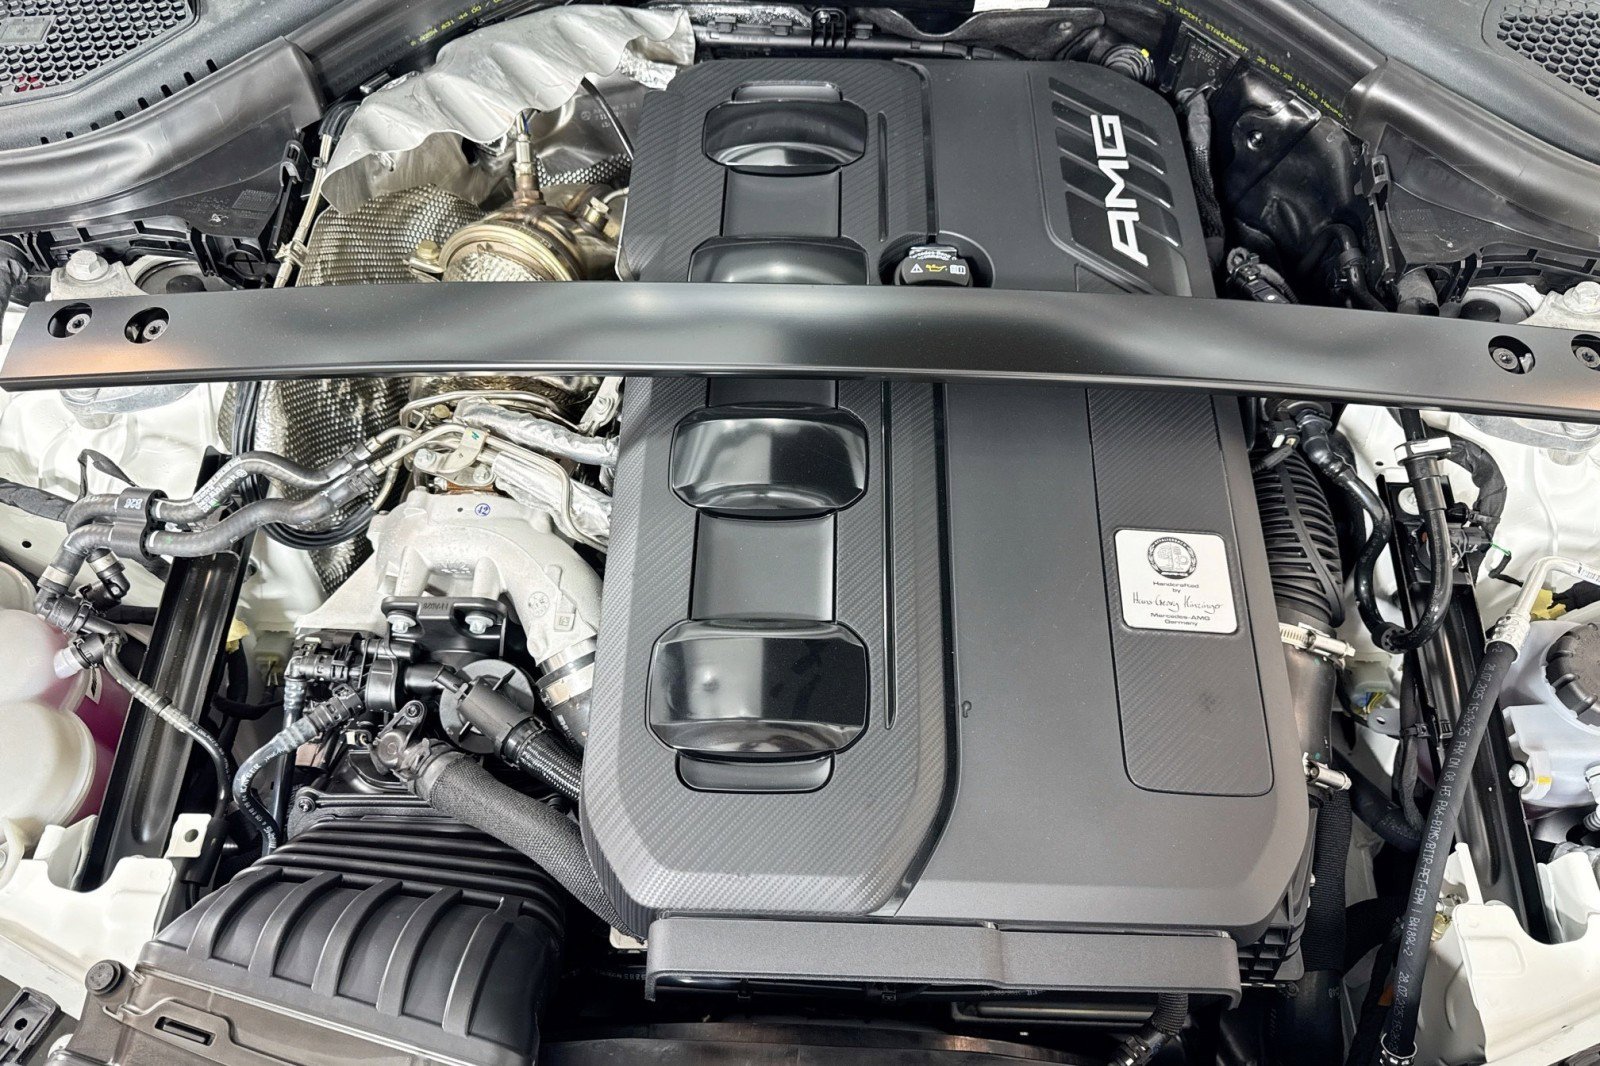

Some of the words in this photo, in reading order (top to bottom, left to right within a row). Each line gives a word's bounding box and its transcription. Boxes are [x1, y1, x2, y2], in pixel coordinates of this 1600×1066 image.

[1090, 114, 1149, 267] AMG
[1150, 612, 1211, 621] Mercedes-AMG
[1447, 757, 1461, 769] DN
[1443, 771, 1456, 782] 08
[1440, 785, 1453, 797] H3
